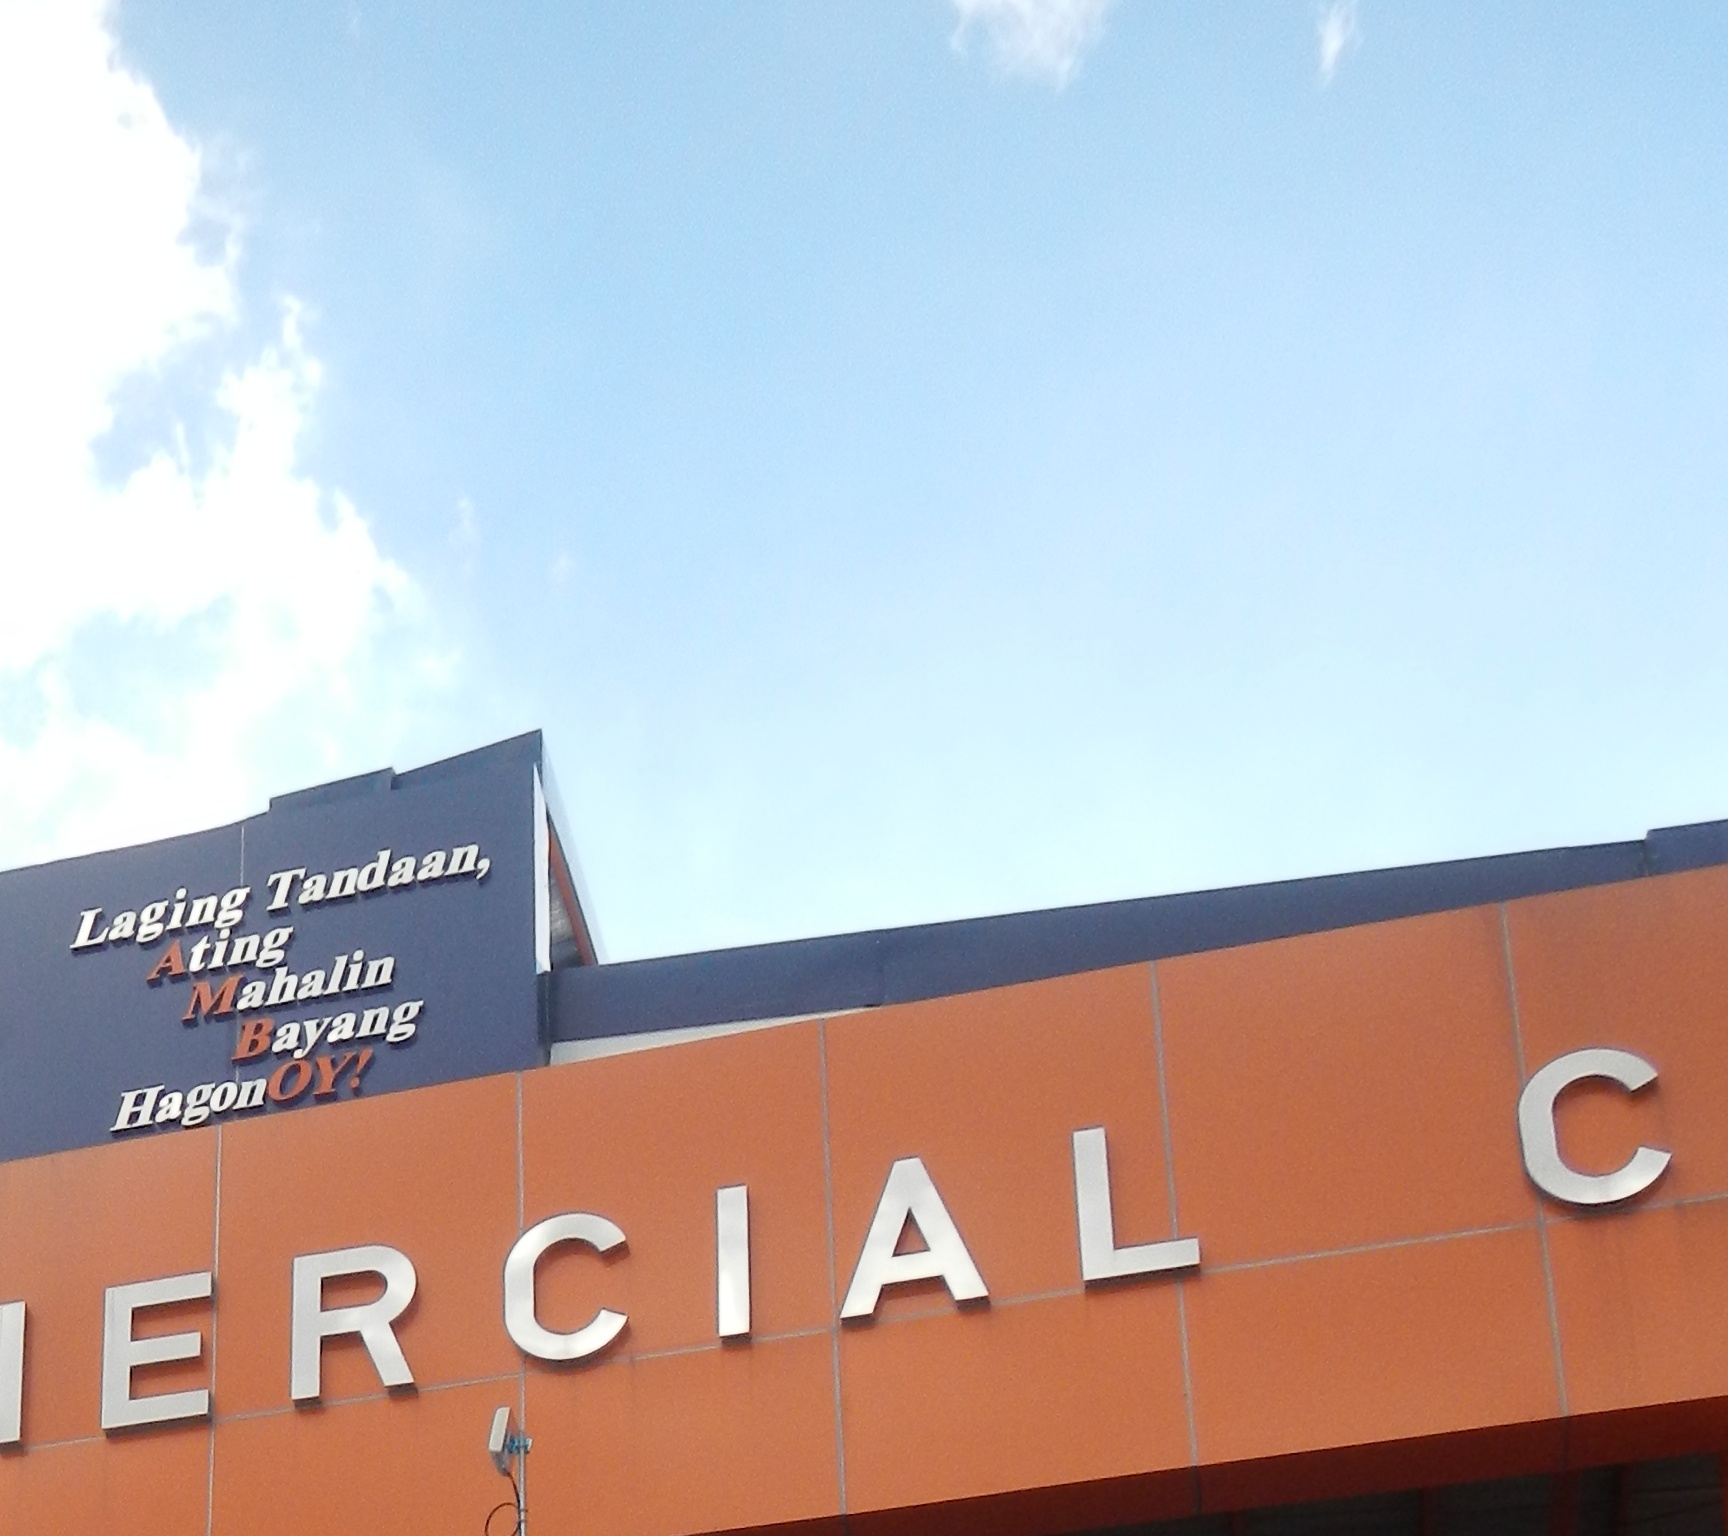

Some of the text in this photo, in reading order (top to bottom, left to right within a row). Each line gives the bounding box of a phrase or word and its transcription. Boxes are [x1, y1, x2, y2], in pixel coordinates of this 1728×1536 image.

[70, 843, 491, 950] Laging Tandaan,
[146, 925, 294, 982] Ating
[182, 949, 395, 1022] Mahalin
[231, 1000, 423, 1062] Bayang
[1517, 1046, 1672, 1205] C
